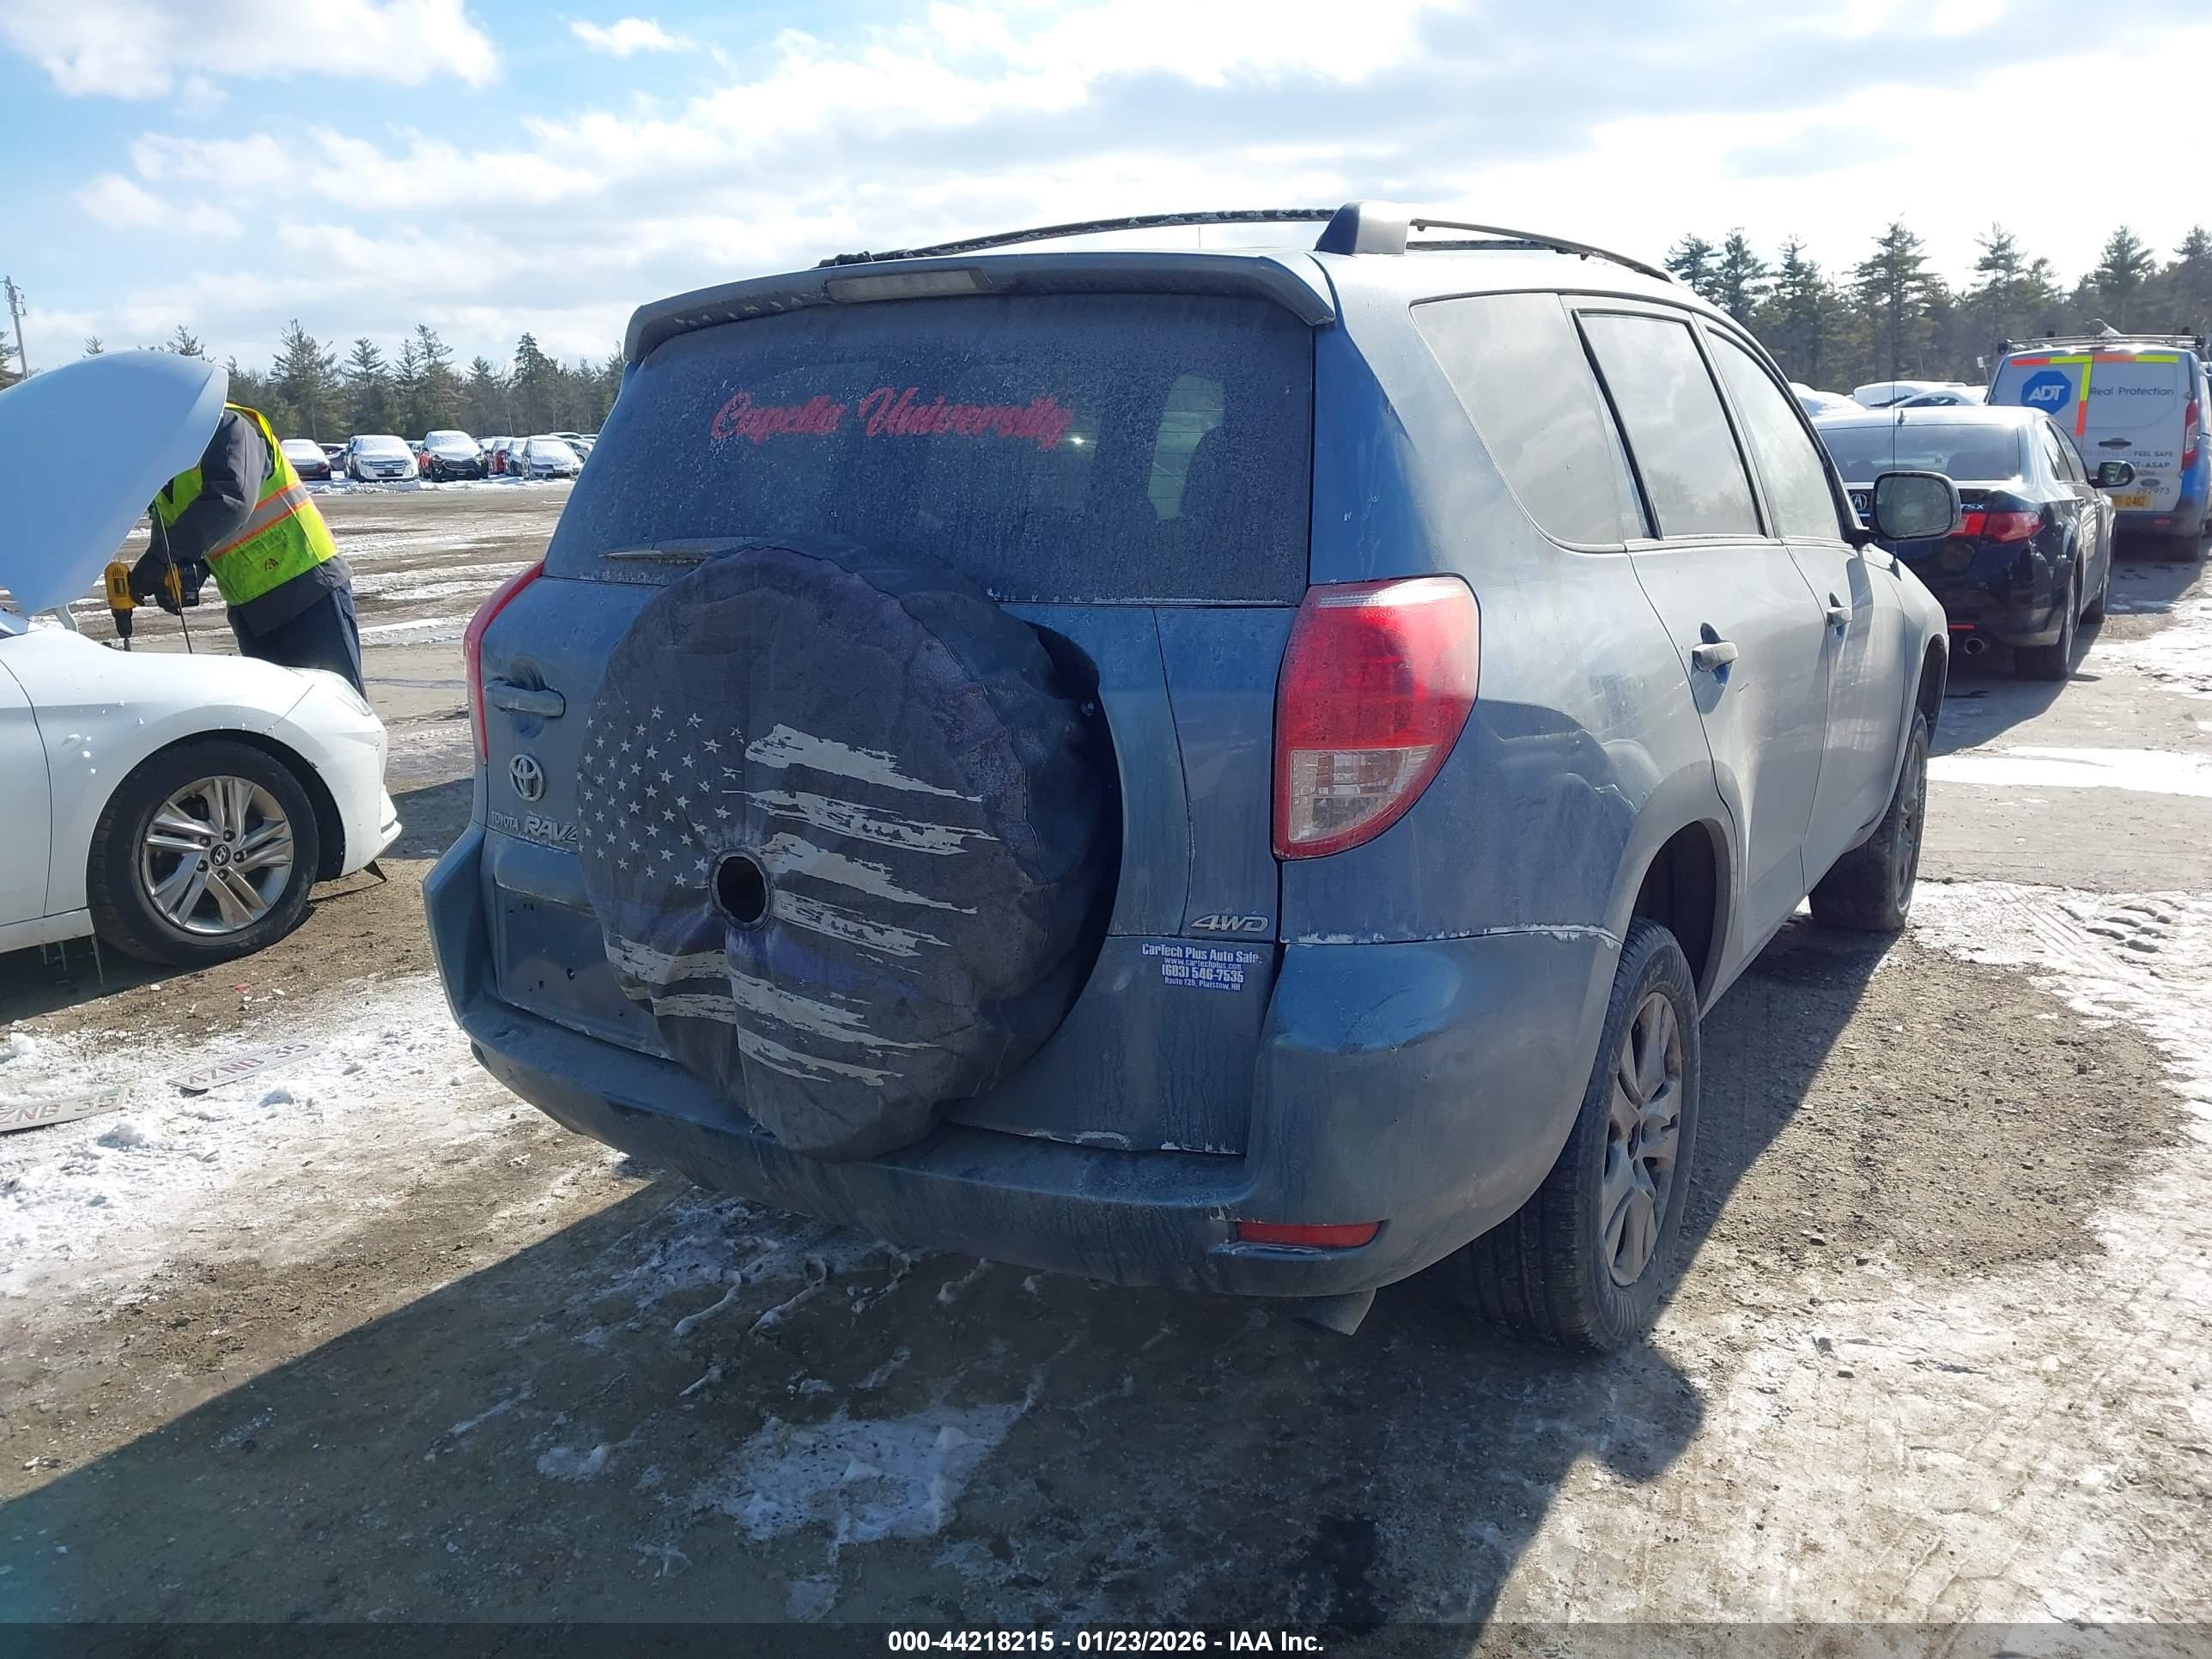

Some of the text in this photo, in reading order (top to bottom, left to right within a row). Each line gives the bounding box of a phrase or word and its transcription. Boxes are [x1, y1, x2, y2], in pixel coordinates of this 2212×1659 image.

[2028, 385, 2064, 401] ADT
[2090, 386, 2174, 396] Real Protection
[858, 387, 1073, 451] University
[491, 811, 519, 830] TOYOTA
[1191, 915, 1268, 932] 4WD
[1142, 944, 1182, 957] CarTech
[1185, 947, 1206, 960] Plus
[1210, 949, 1233, 962] Auto
[1164, 957, 1242, 970] www.cartechplus.com
[1162, 964, 1243, 982] (603) 546-7535
[1164, 976, 1182, 985] Route
